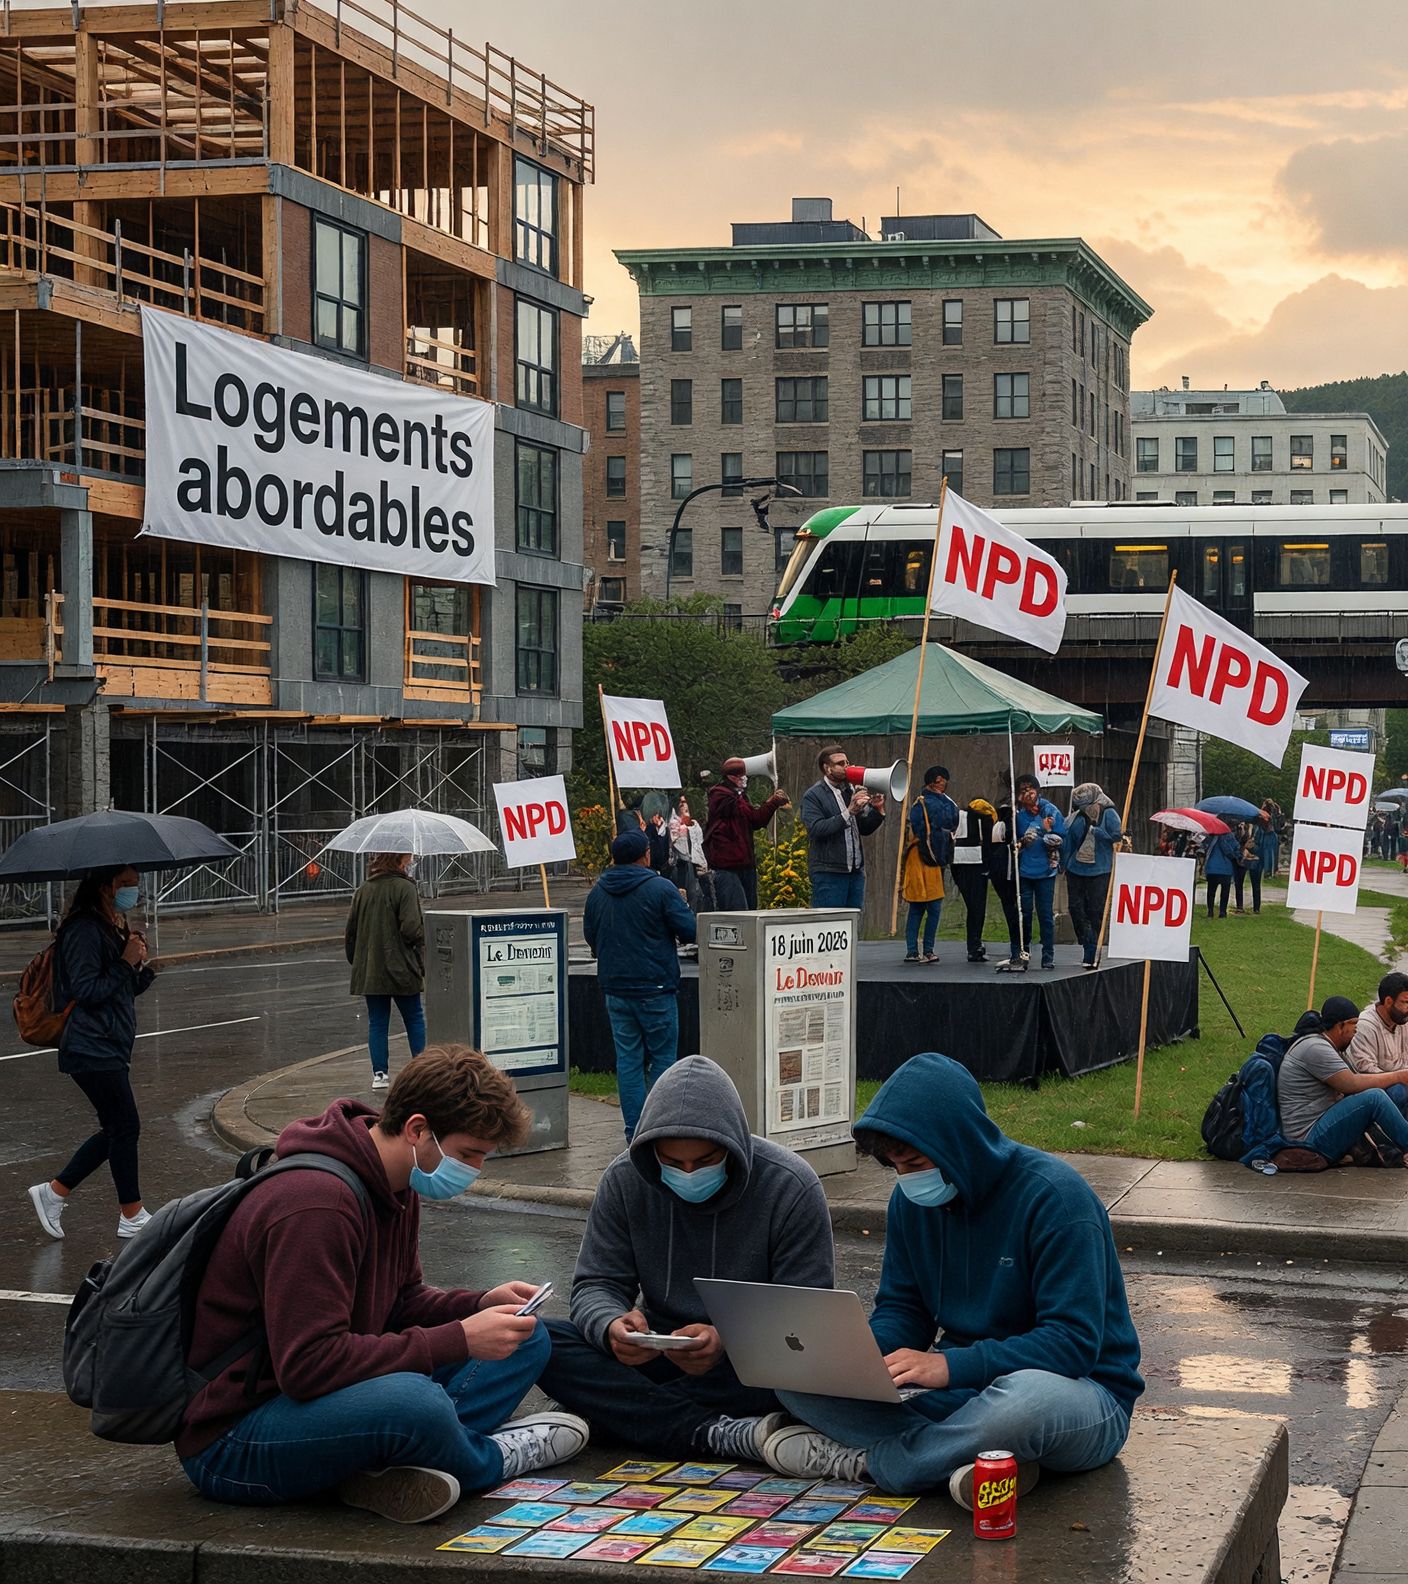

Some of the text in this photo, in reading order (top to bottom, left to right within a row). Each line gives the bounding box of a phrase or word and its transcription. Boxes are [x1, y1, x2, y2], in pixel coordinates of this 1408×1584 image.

[174, 341, 474, 479] Logements
[176, 444, 475, 558] abordables
[944, 526, 1059, 617] NPD
[1167, 624, 1289, 726] NPD
[611, 720, 672, 762] NPD
[1302, 765, 1368, 805] NPD
[503, 800, 567, 842] NPD
[1294, 848, 1357, 887] NPD
[1117, 883, 1188, 928] NPD
[487, 944, 502, 961] Le
[771, 930, 848, 960] 18 juin 2026
